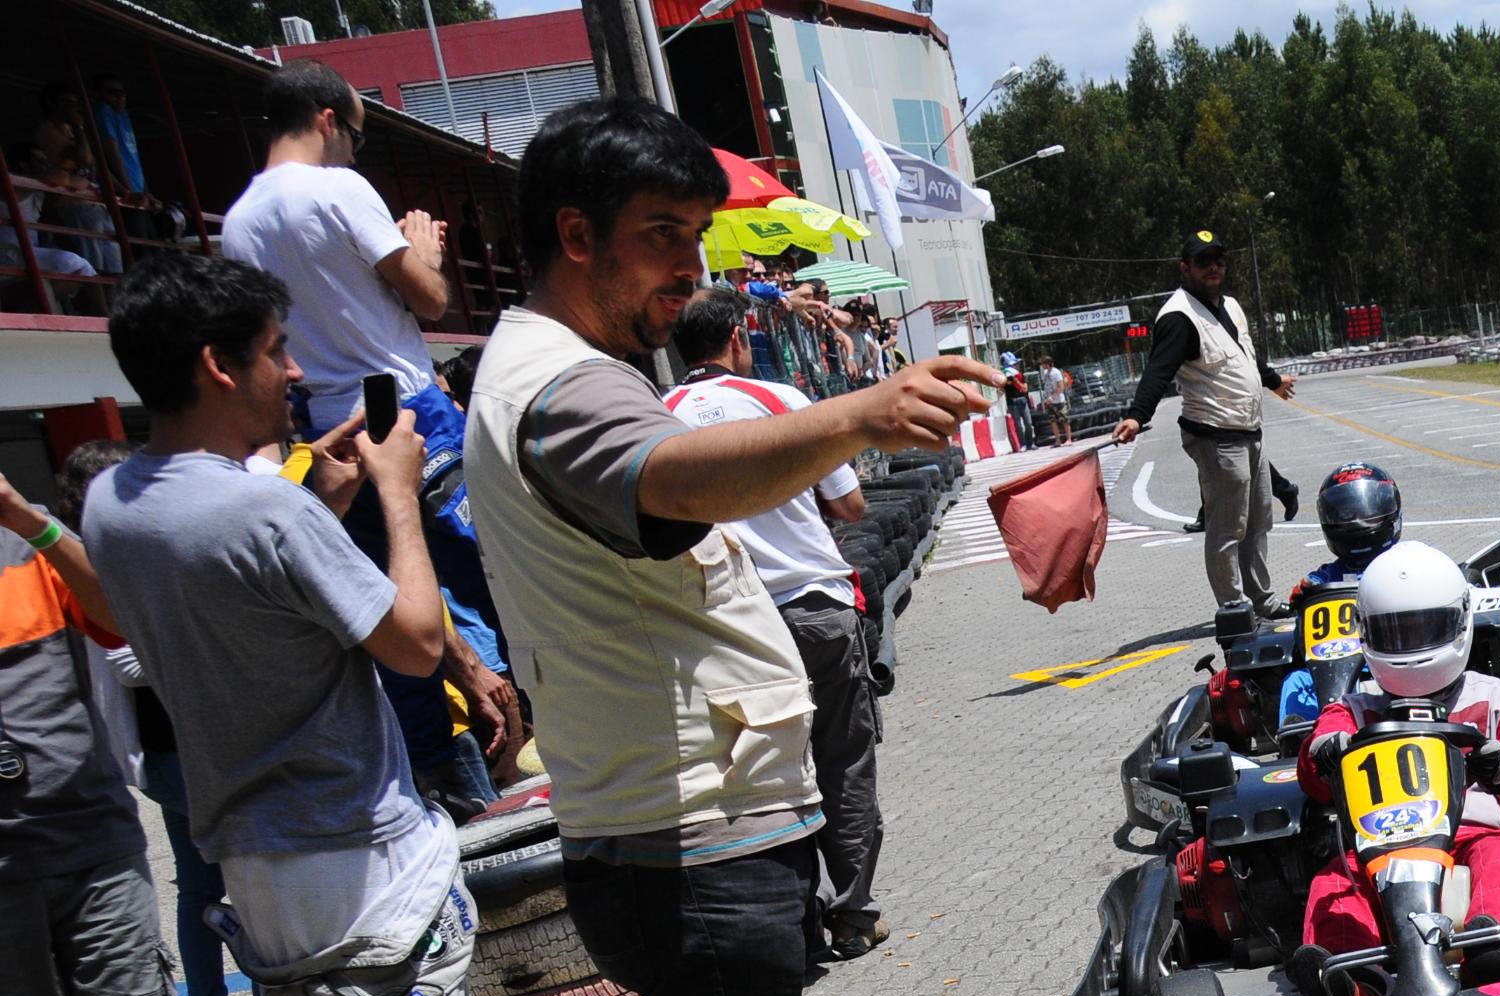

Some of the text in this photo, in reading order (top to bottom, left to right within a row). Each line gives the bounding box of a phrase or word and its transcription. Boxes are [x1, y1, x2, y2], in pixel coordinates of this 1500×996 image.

[702, 411, 721, 421] POR
[1312, 603, 1357, 641] 99
[1357, 743, 1430, 806] 10
[1381, 808, 1410, 829] 24
